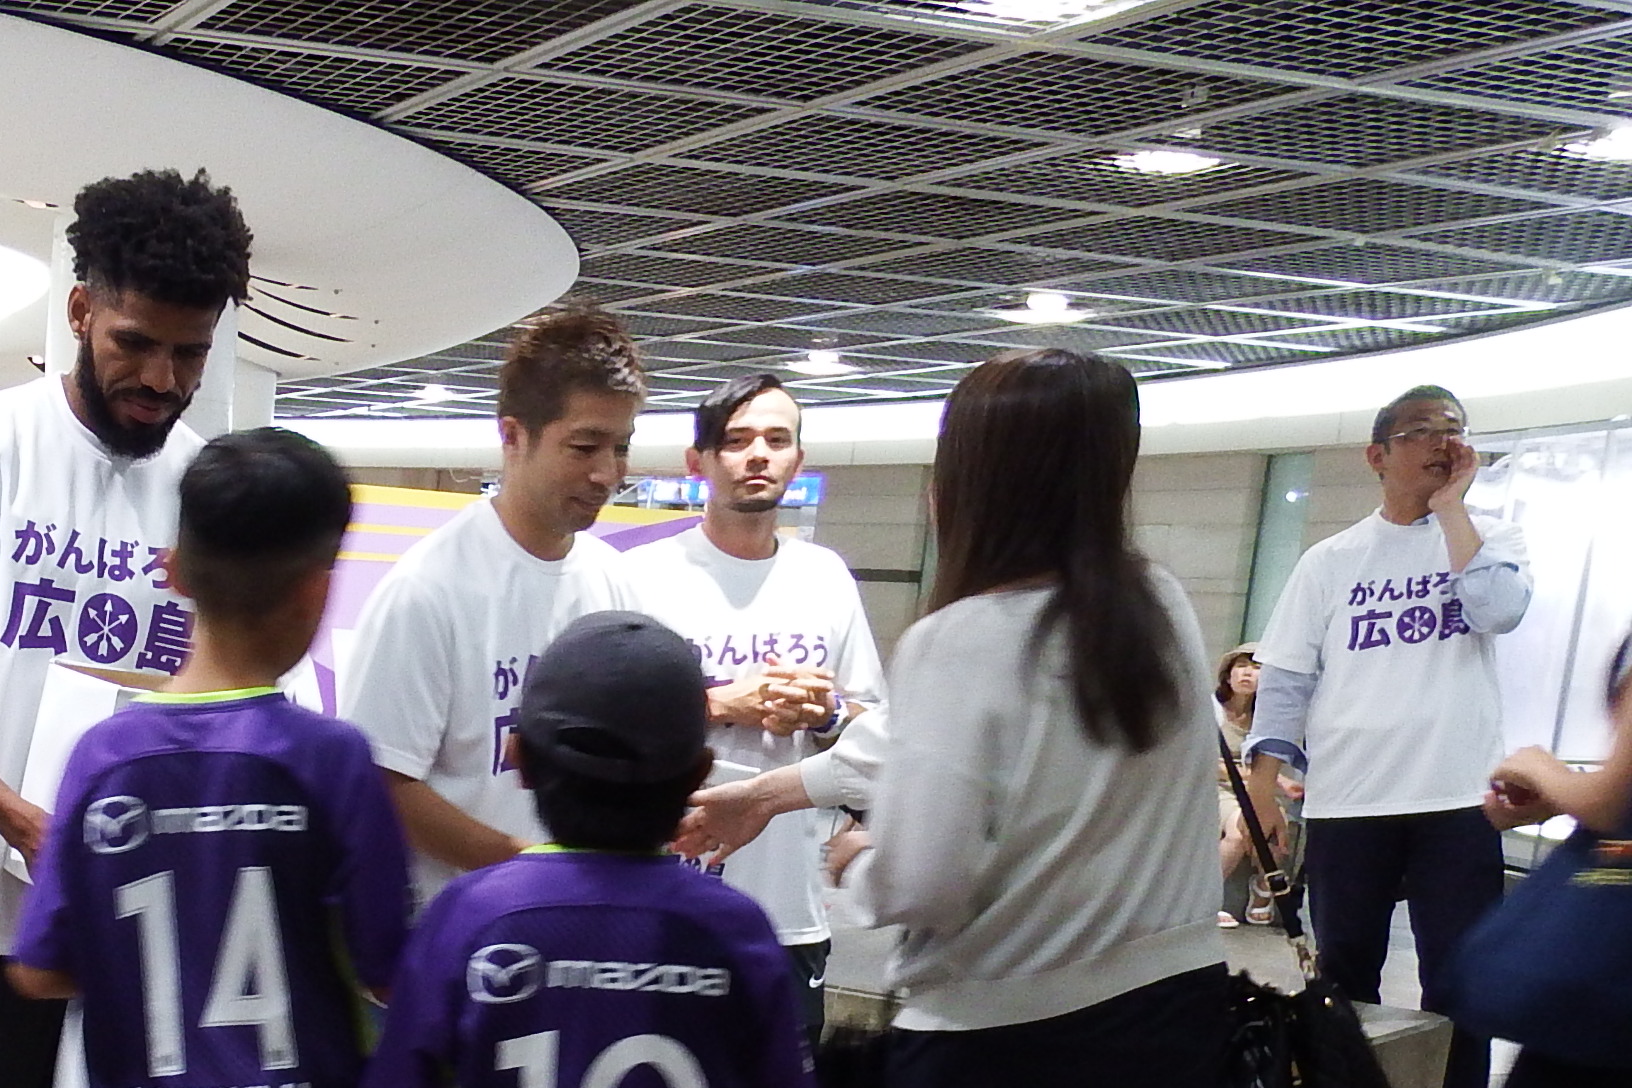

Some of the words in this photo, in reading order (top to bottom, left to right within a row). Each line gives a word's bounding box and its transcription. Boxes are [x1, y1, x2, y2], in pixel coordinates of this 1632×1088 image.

[11, 519, 176, 589] がんばろ
[1348, 571, 1450, 606] がんばろ
[113, 866, 300, 1078] 14
